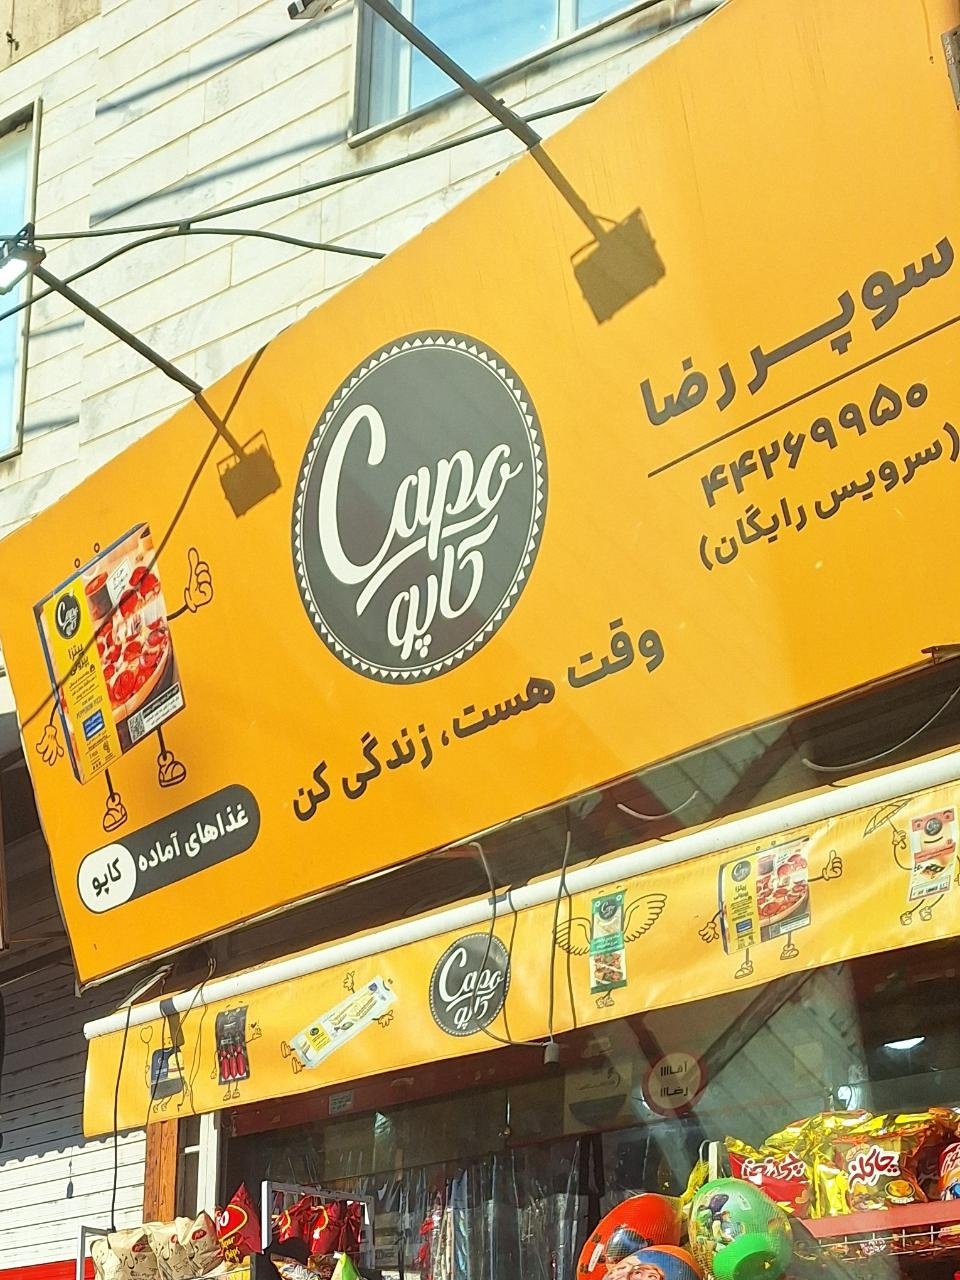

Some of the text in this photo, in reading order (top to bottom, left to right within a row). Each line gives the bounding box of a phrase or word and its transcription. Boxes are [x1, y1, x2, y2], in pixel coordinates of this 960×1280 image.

[639, 236, 955, 426] سوپر رضا
[700, 382, 928, 508] ۴۴۲۶۹۹۵۰
[317, 403, 523, 585] Capo
[699, 497, 807, 571] رایگان)
[386, 514, 500, 661] کاپو
[567, 617, 665, 689] وقت
[291, 760, 331, 822] کن
[341, 723, 433, 800] زندگی
[138, 803, 249, 872] غذاهای آماده
[91, 857, 122, 898] کاپو
[439, 947, 504, 1002] Capo
